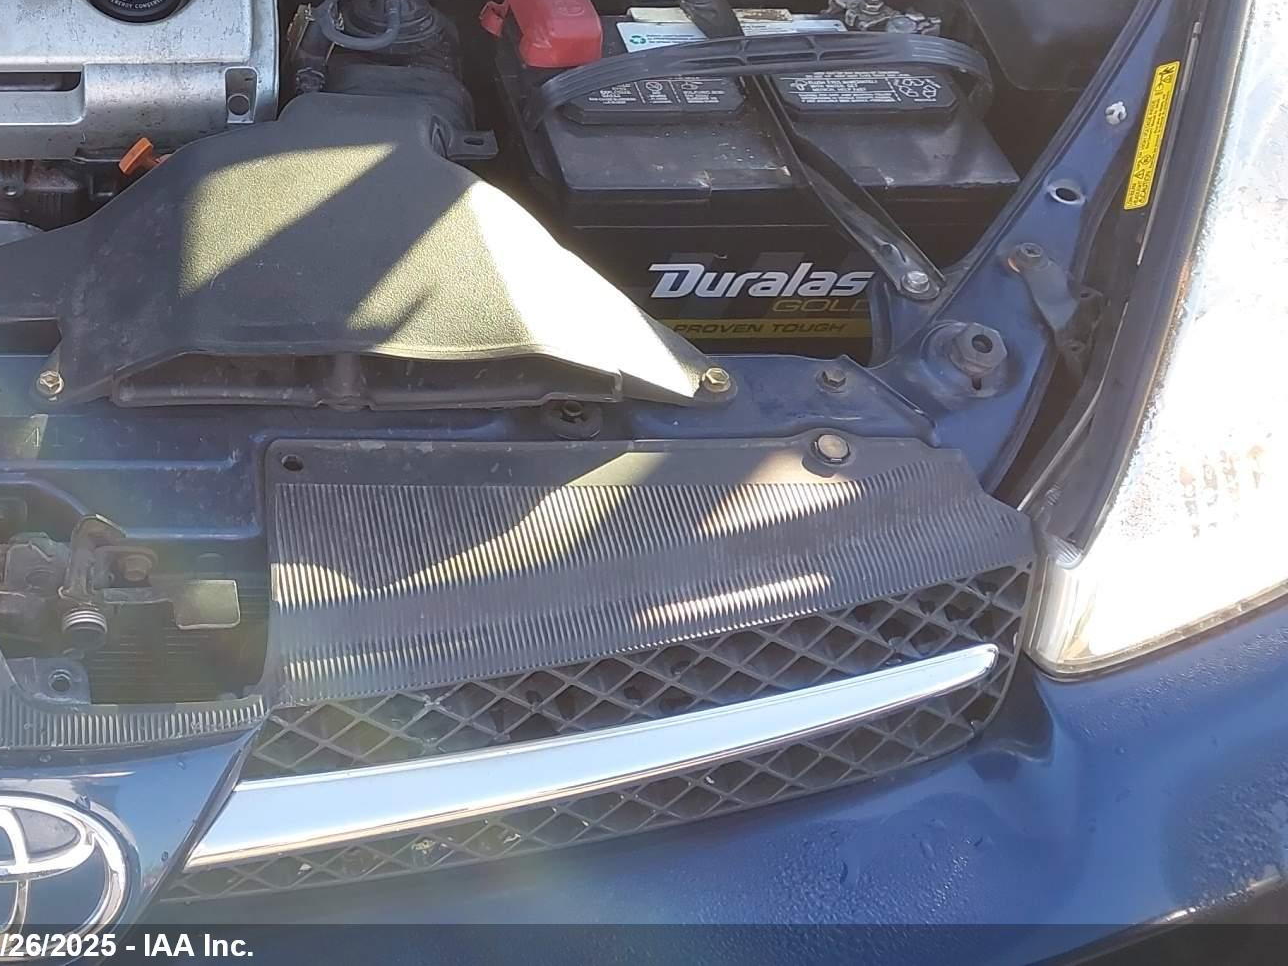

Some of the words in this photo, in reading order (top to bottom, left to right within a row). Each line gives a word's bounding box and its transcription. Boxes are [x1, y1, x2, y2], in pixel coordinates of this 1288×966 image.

[648, 262, 875, 298] Duralas
[674, 323, 762, 334] PROVEN
[772, 323, 847, 333] TOUGH
